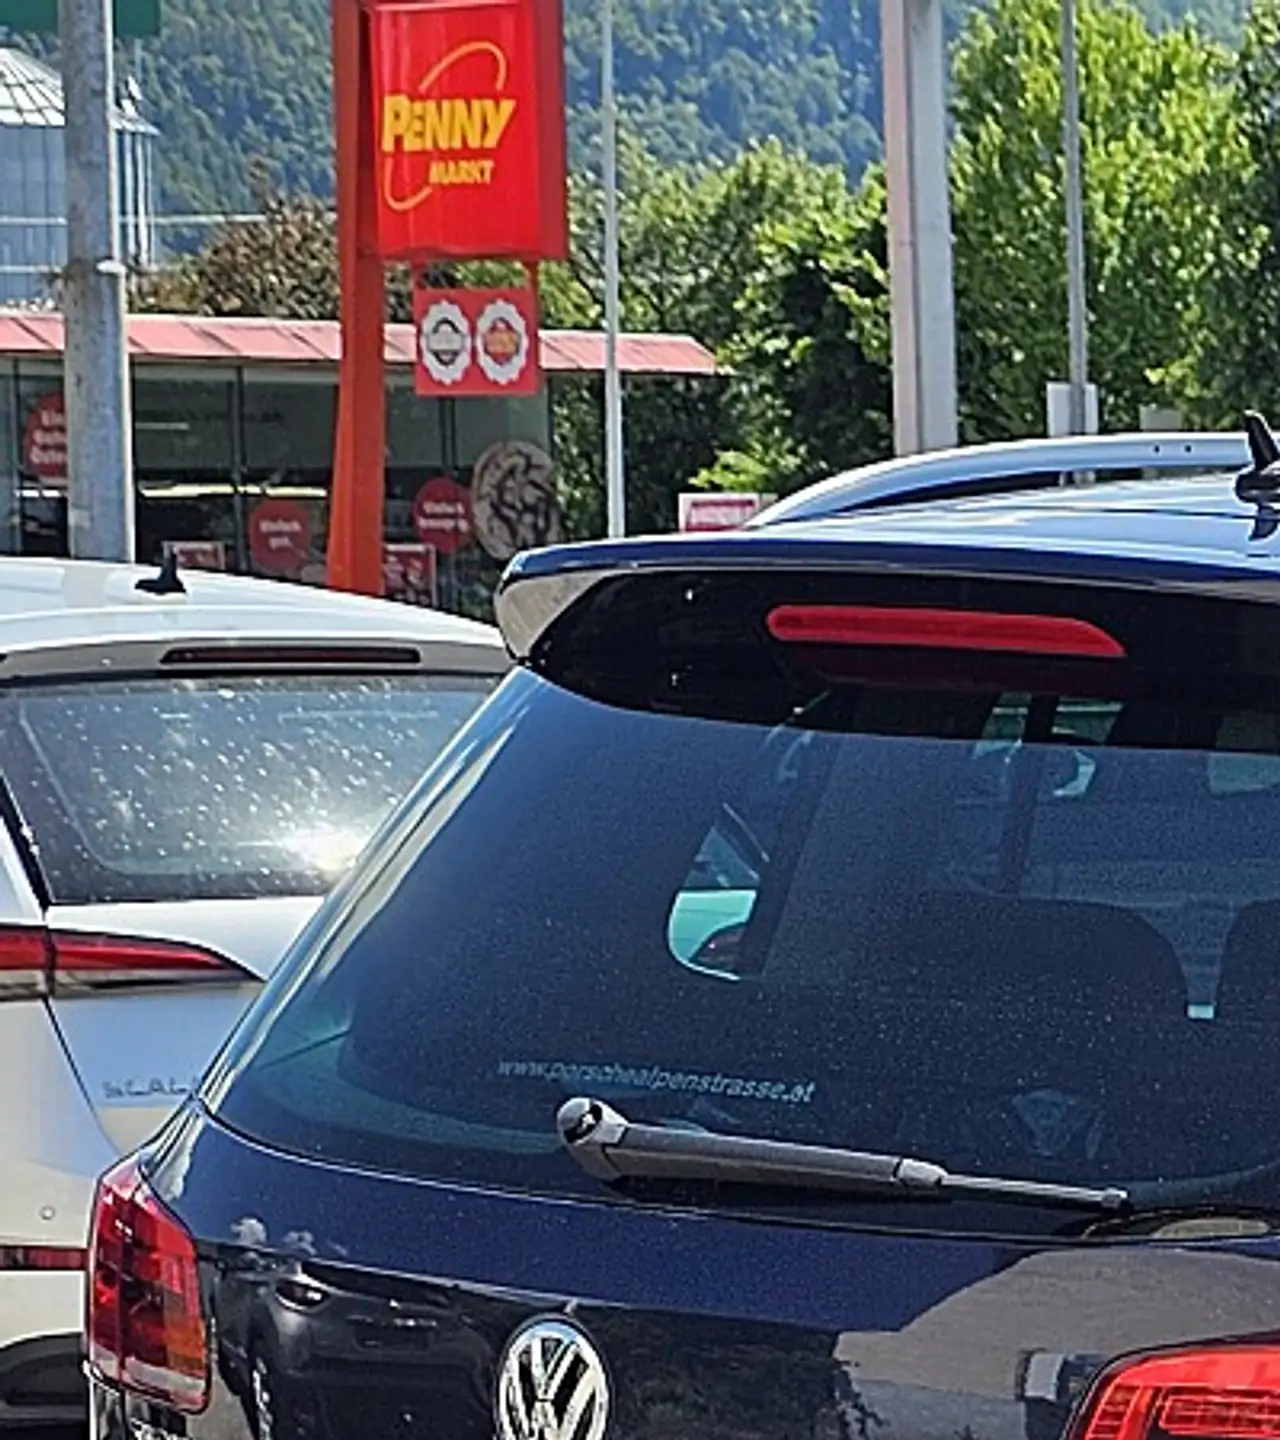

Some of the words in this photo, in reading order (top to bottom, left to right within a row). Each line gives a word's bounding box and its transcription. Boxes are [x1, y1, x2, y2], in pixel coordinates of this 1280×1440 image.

[382, 94, 516, 153] PENNY
[429, 160, 494, 185] MARKT
[499, 1060, 816, 1103] www.porschealpenstrasse.at
